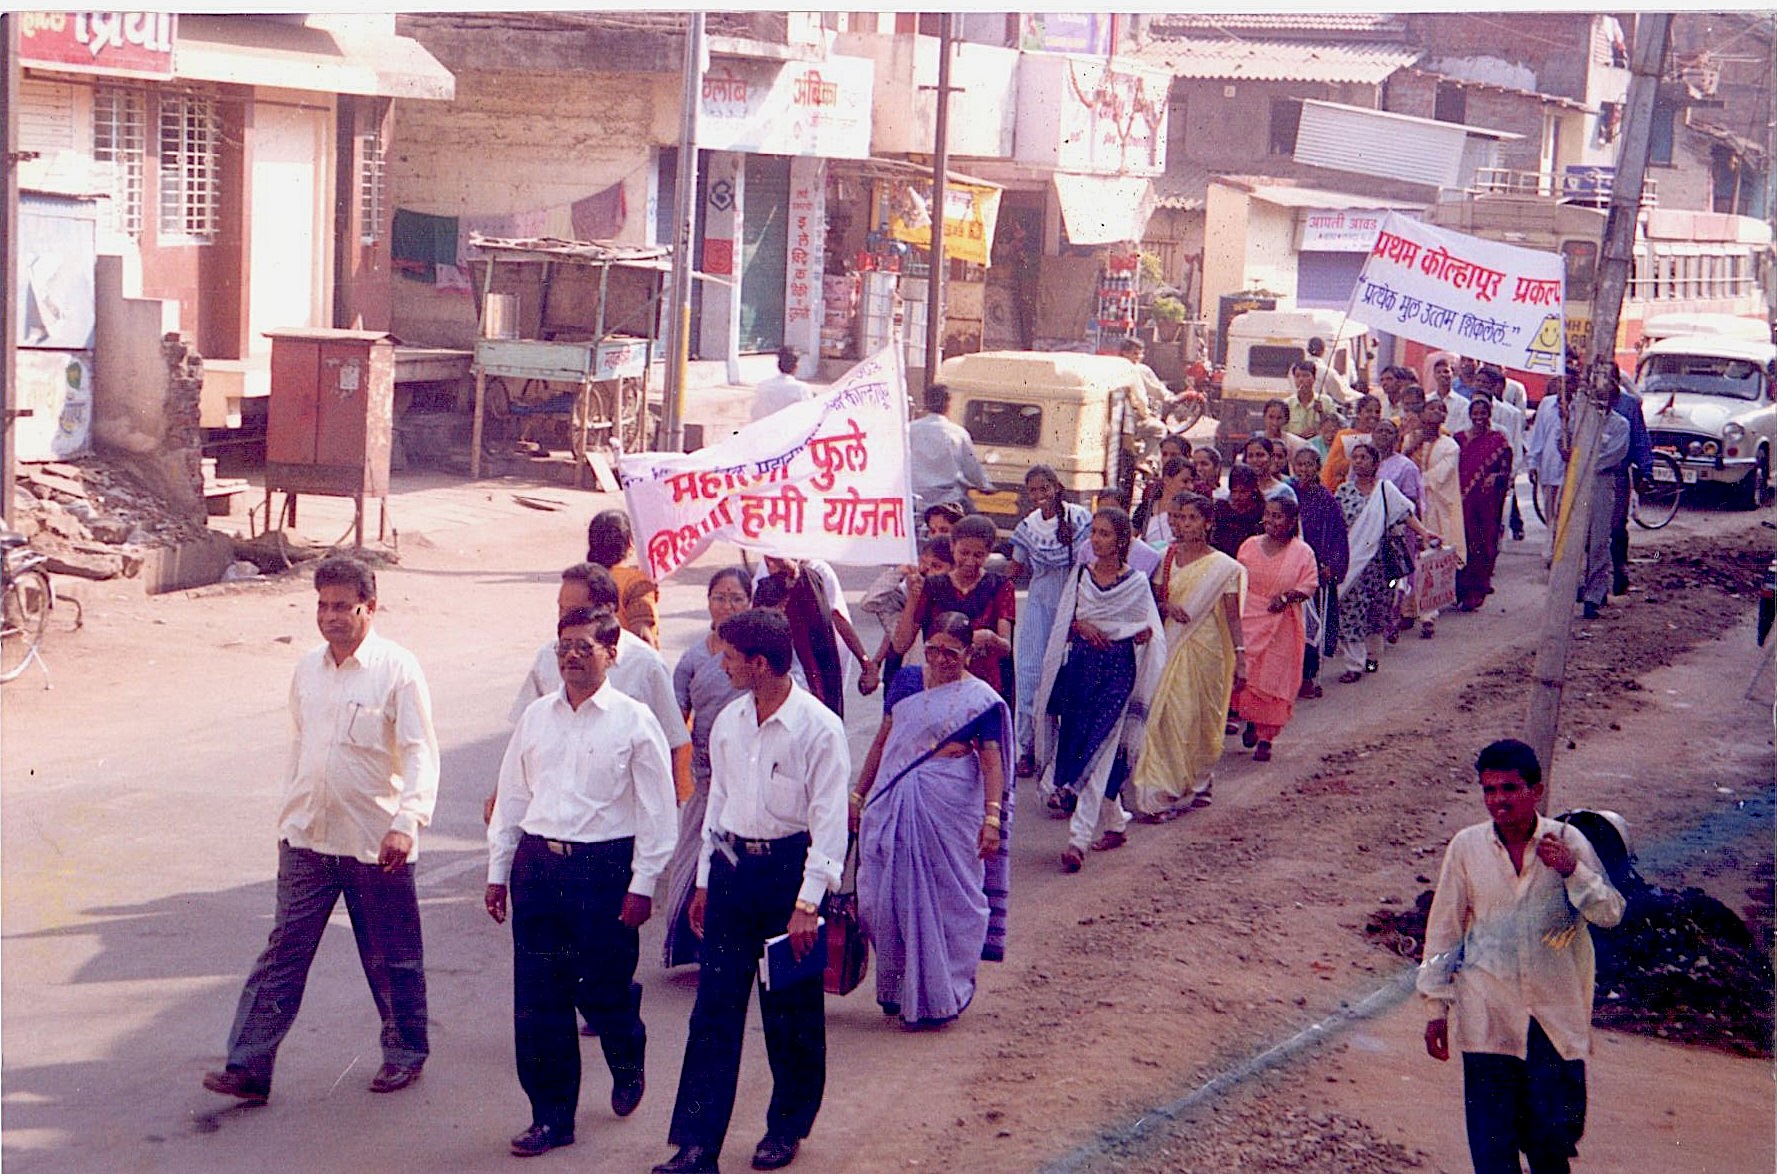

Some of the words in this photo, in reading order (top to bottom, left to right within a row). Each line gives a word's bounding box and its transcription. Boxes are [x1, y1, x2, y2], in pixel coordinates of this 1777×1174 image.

[1371, 230, 1422, 269] प्रथम
[1421, 245, 1507, 302] कोल्हापूर
[1420, 302, 1459, 331] उत्तम
[809, 417, 868, 492] फुले
[740, 483, 808, 539] हमी
[823, 486, 906, 539] योजना
